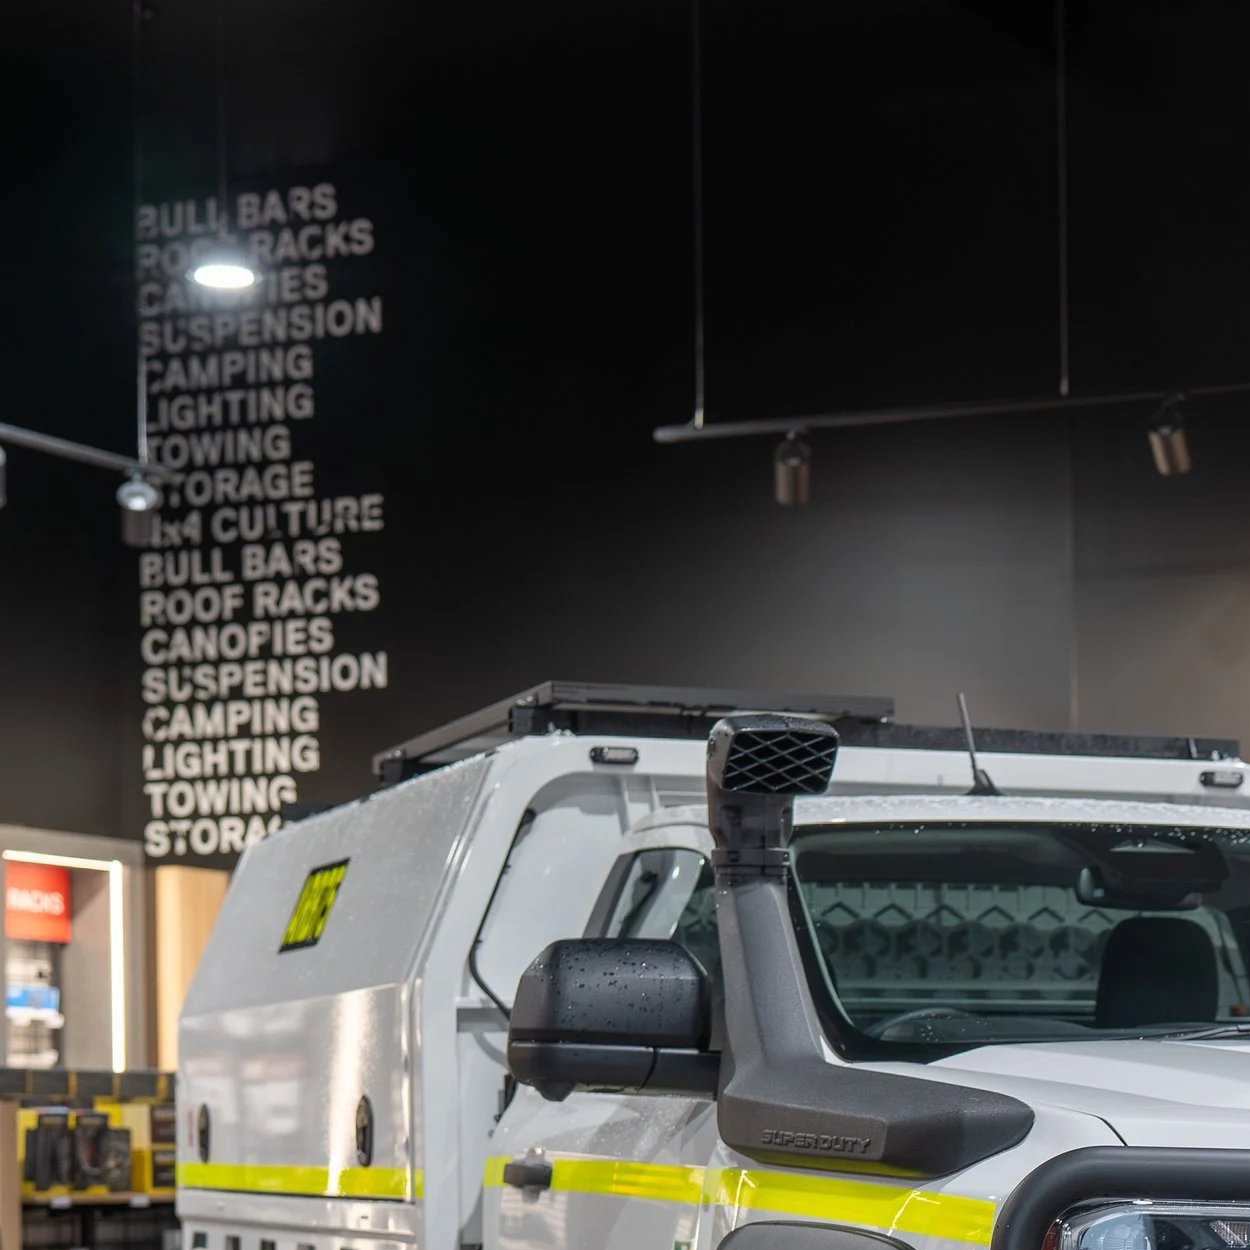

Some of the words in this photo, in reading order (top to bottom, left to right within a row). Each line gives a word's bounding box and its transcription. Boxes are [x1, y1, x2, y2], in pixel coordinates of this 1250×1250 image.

[138, 200, 228, 239] BULL
[238, 184, 337, 228] BARS
[138, 234, 240, 280] RO
[253, 220, 375, 262] RACKS
[138, 264, 329, 317] CAIES
[139, 296, 383, 356] SUSPENSION
[147, 425, 292, 469] TOWING
[211, 494, 386, 544] CULTURE
[139, 547, 234, 588] BULL
[241, 538, 343, 581] BARS
[140, 584, 245, 627] ROOF
[253, 574, 381, 619] RACKS
[141, 617, 335, 666] CANOPIES
[142, 651, 389, 704] SUSPENSION
[142, 696, 320, 741] CAMPING
[143, 734, 320, 782] LIGHTING
[143, 775, 298, 819] TOWING
[144, 814, 282, 858] STORA
[760, 1129, 818, 1150] SUPER
[819, 1134, 872, 1154] DUTY
